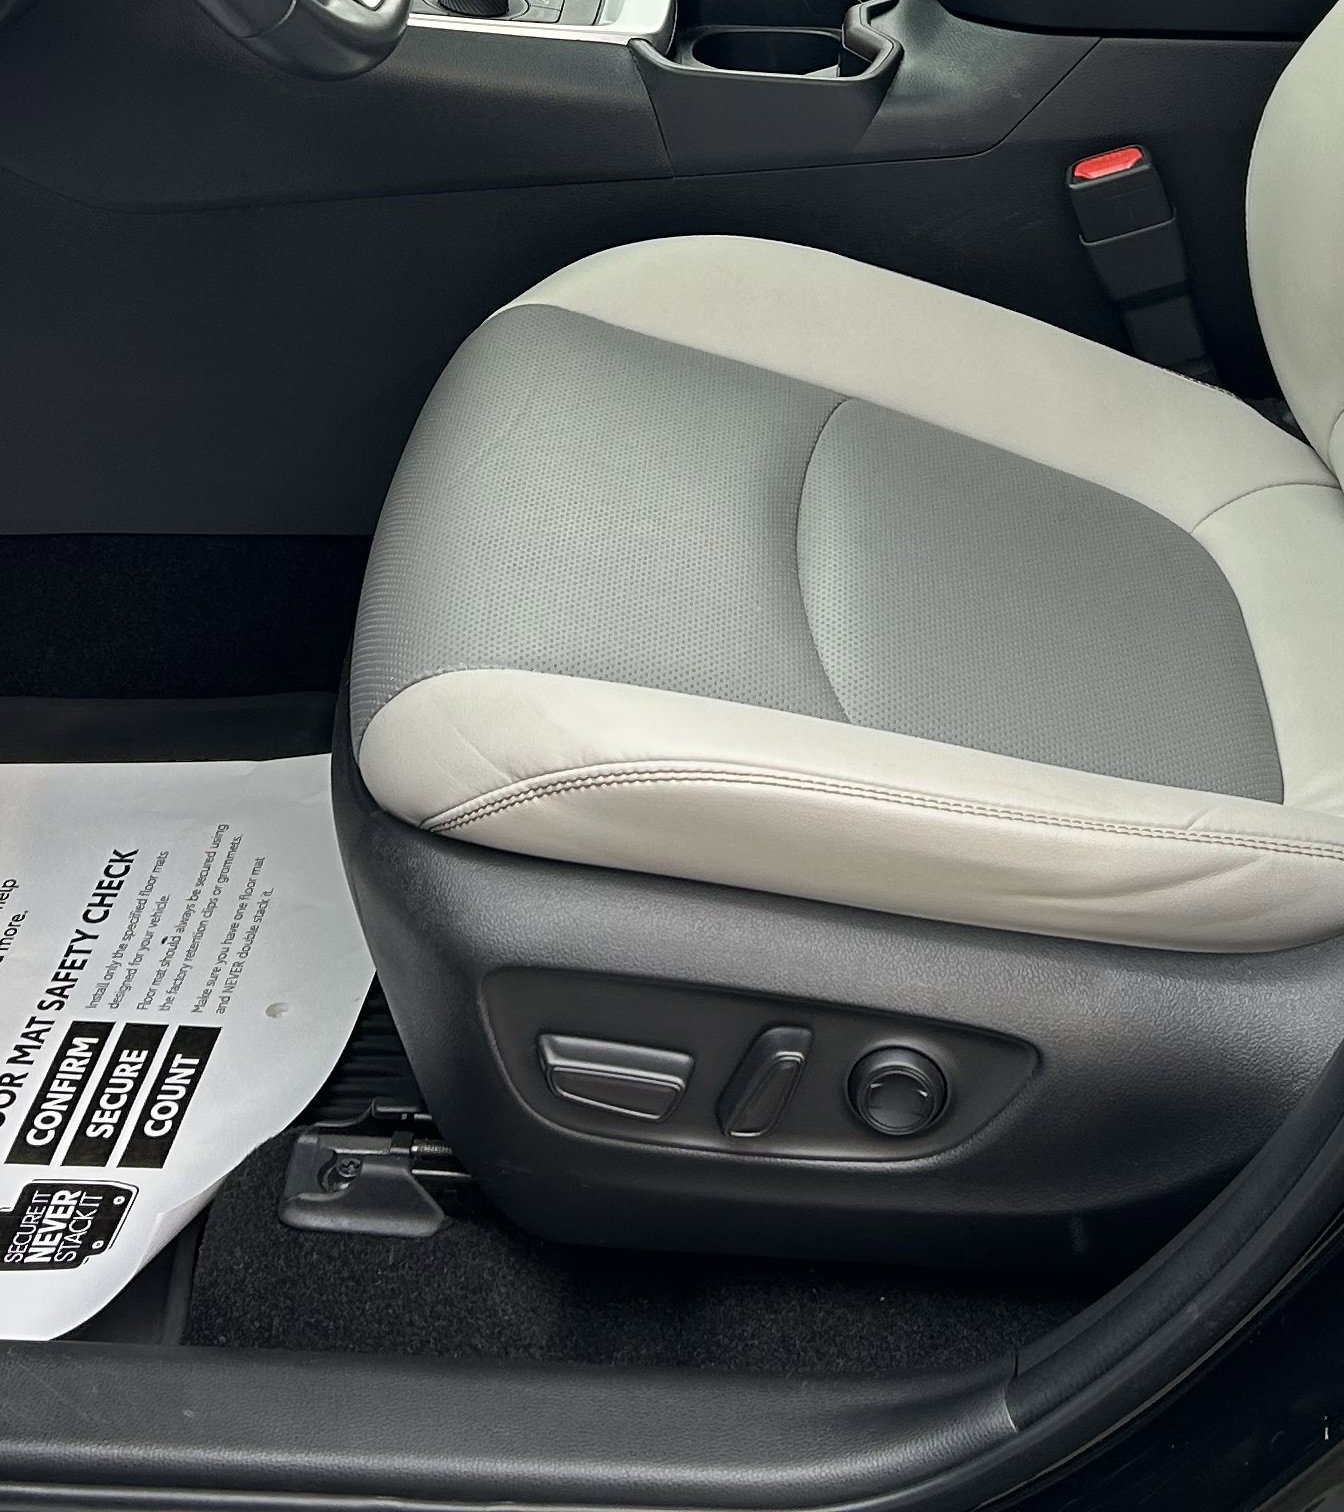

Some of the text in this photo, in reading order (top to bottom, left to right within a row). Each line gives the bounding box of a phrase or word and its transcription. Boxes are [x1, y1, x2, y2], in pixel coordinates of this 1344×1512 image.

[135, 823, 230, 1010] Floor mat should always be secured using
[200, 897, 219, 919] clips
[212, 884, 223, 896] or
[252, 898, 271, 924] stack
[5, 1015, 56, 1066] MAT
[36, 928, 100, 1011] SAFETY
[81, 848, 140, 924] CHECK
[84, 850, 170, 1009] Install only the specified floor mats
[183, 919, 209, 962] retention
[190, 856, 266, 1013] Make sure you have one floor mat
[236, 924, 260, 959] double
[107, 967, 138, 1010] designed
[127, 952, 145, 967] for
[137, 929, 155, 952] your
[158, 995, 176, 1011] the
[165, 962, 193, 995] factory
[215, 995, 231, 1015] and
[221, 960, 246, 994] NEVER
[26, 1037, 100, 1147] CONFIRM
[86, 1049, 149, 1139] SECURE
[143, 1053, 200, 1138] COUNT
[4, 1190, 52, 1263] SECURE IT
[23, 1190, 82, 1264] NEVER
[54, 1192, 103, 1262] STACK IT
